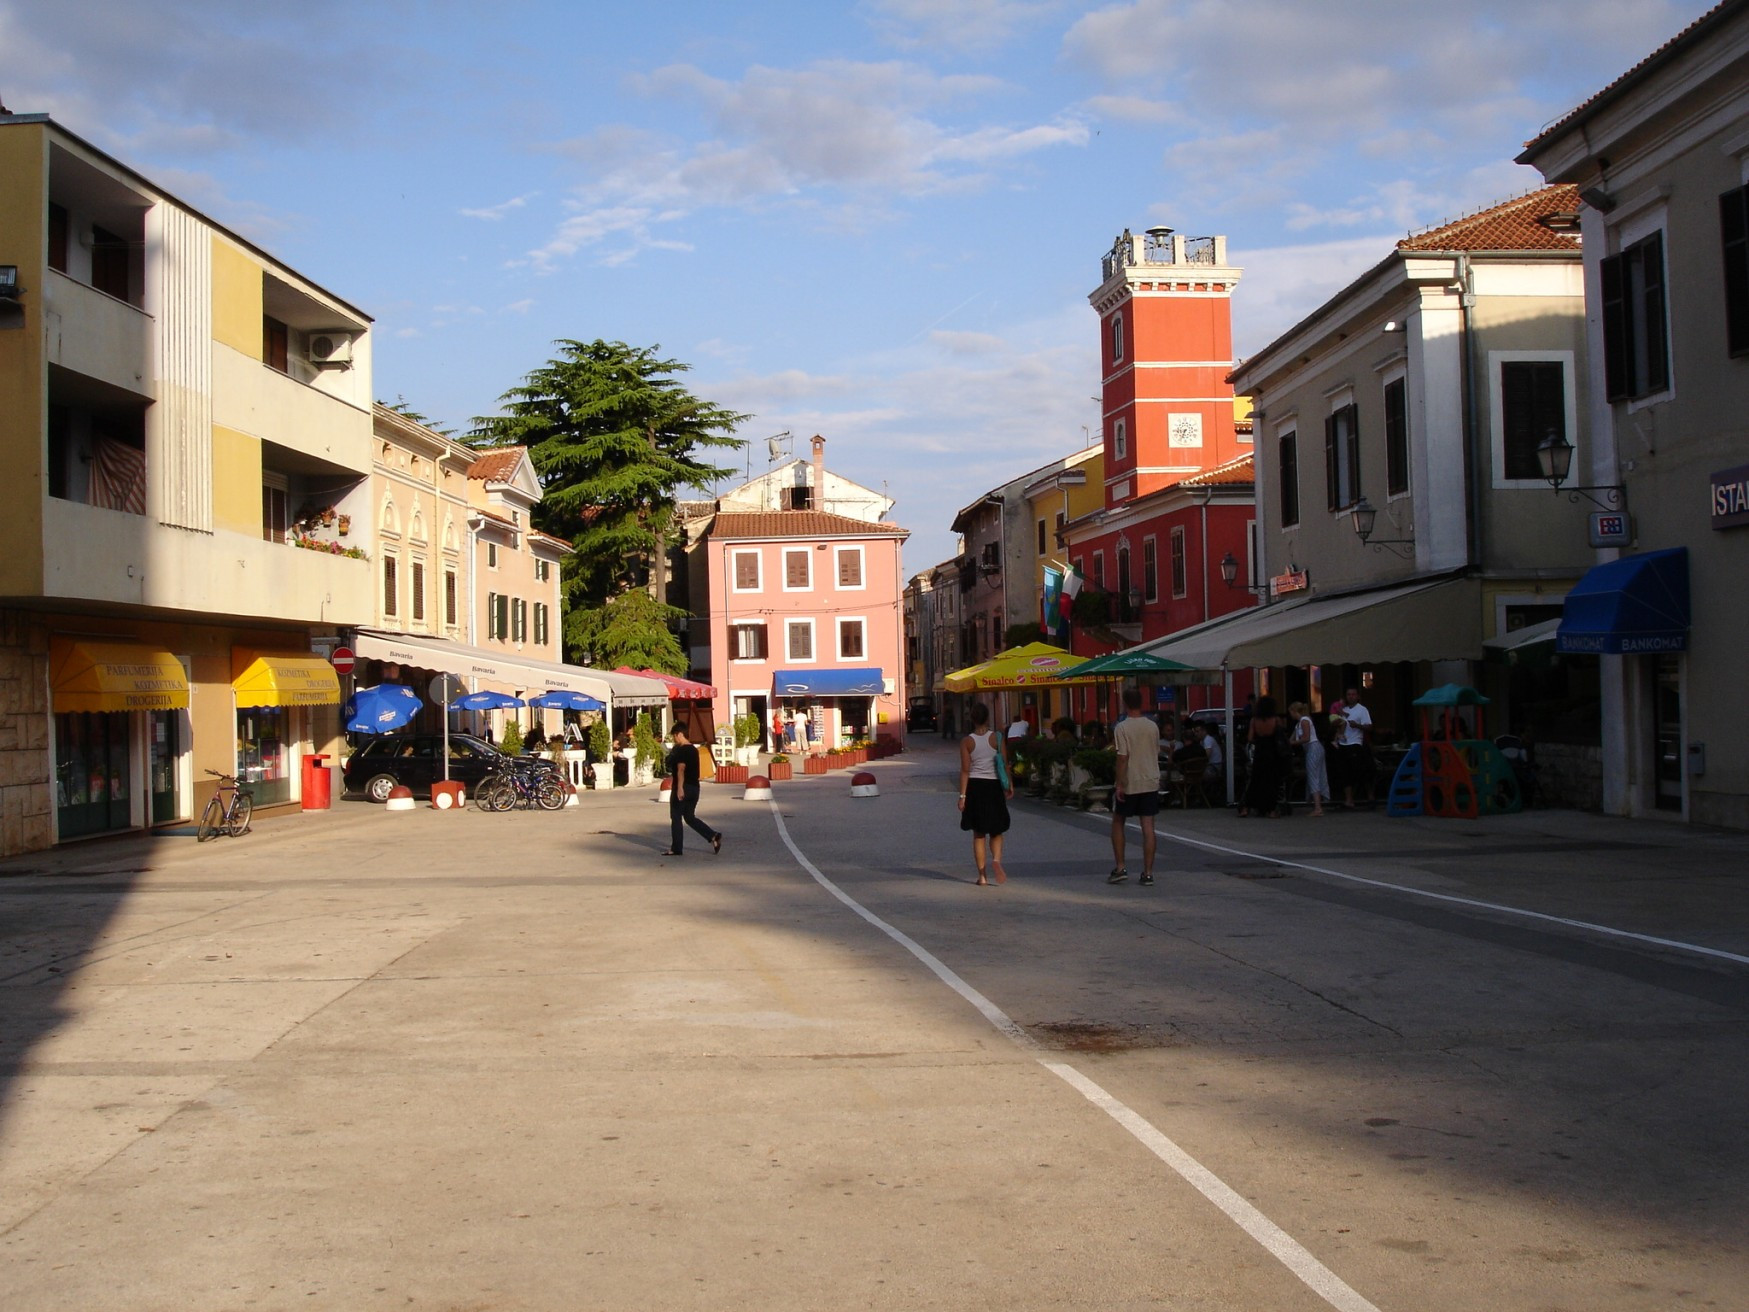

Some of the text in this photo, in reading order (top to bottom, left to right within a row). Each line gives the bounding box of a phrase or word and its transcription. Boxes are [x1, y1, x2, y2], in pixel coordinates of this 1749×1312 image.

[1711, 482, 1749, 516] ISTA
[1561, 635, 1605, 650] BANKOMAT
[1621, 636, 1684, 651] BANKOMAT
[389, 651, 414, 660] Bavaria
[106, 665, 164, 678] PARFUMERIJA
[472, 665, 496, 675] Bavaria
[134, 679, 183, 689] KOZMETIKA
[545, 679, 569, 688] Bavaria
[982, 676, 1014, 685] Sinalco
[126, 695, 173, 707] DROGERIJA
